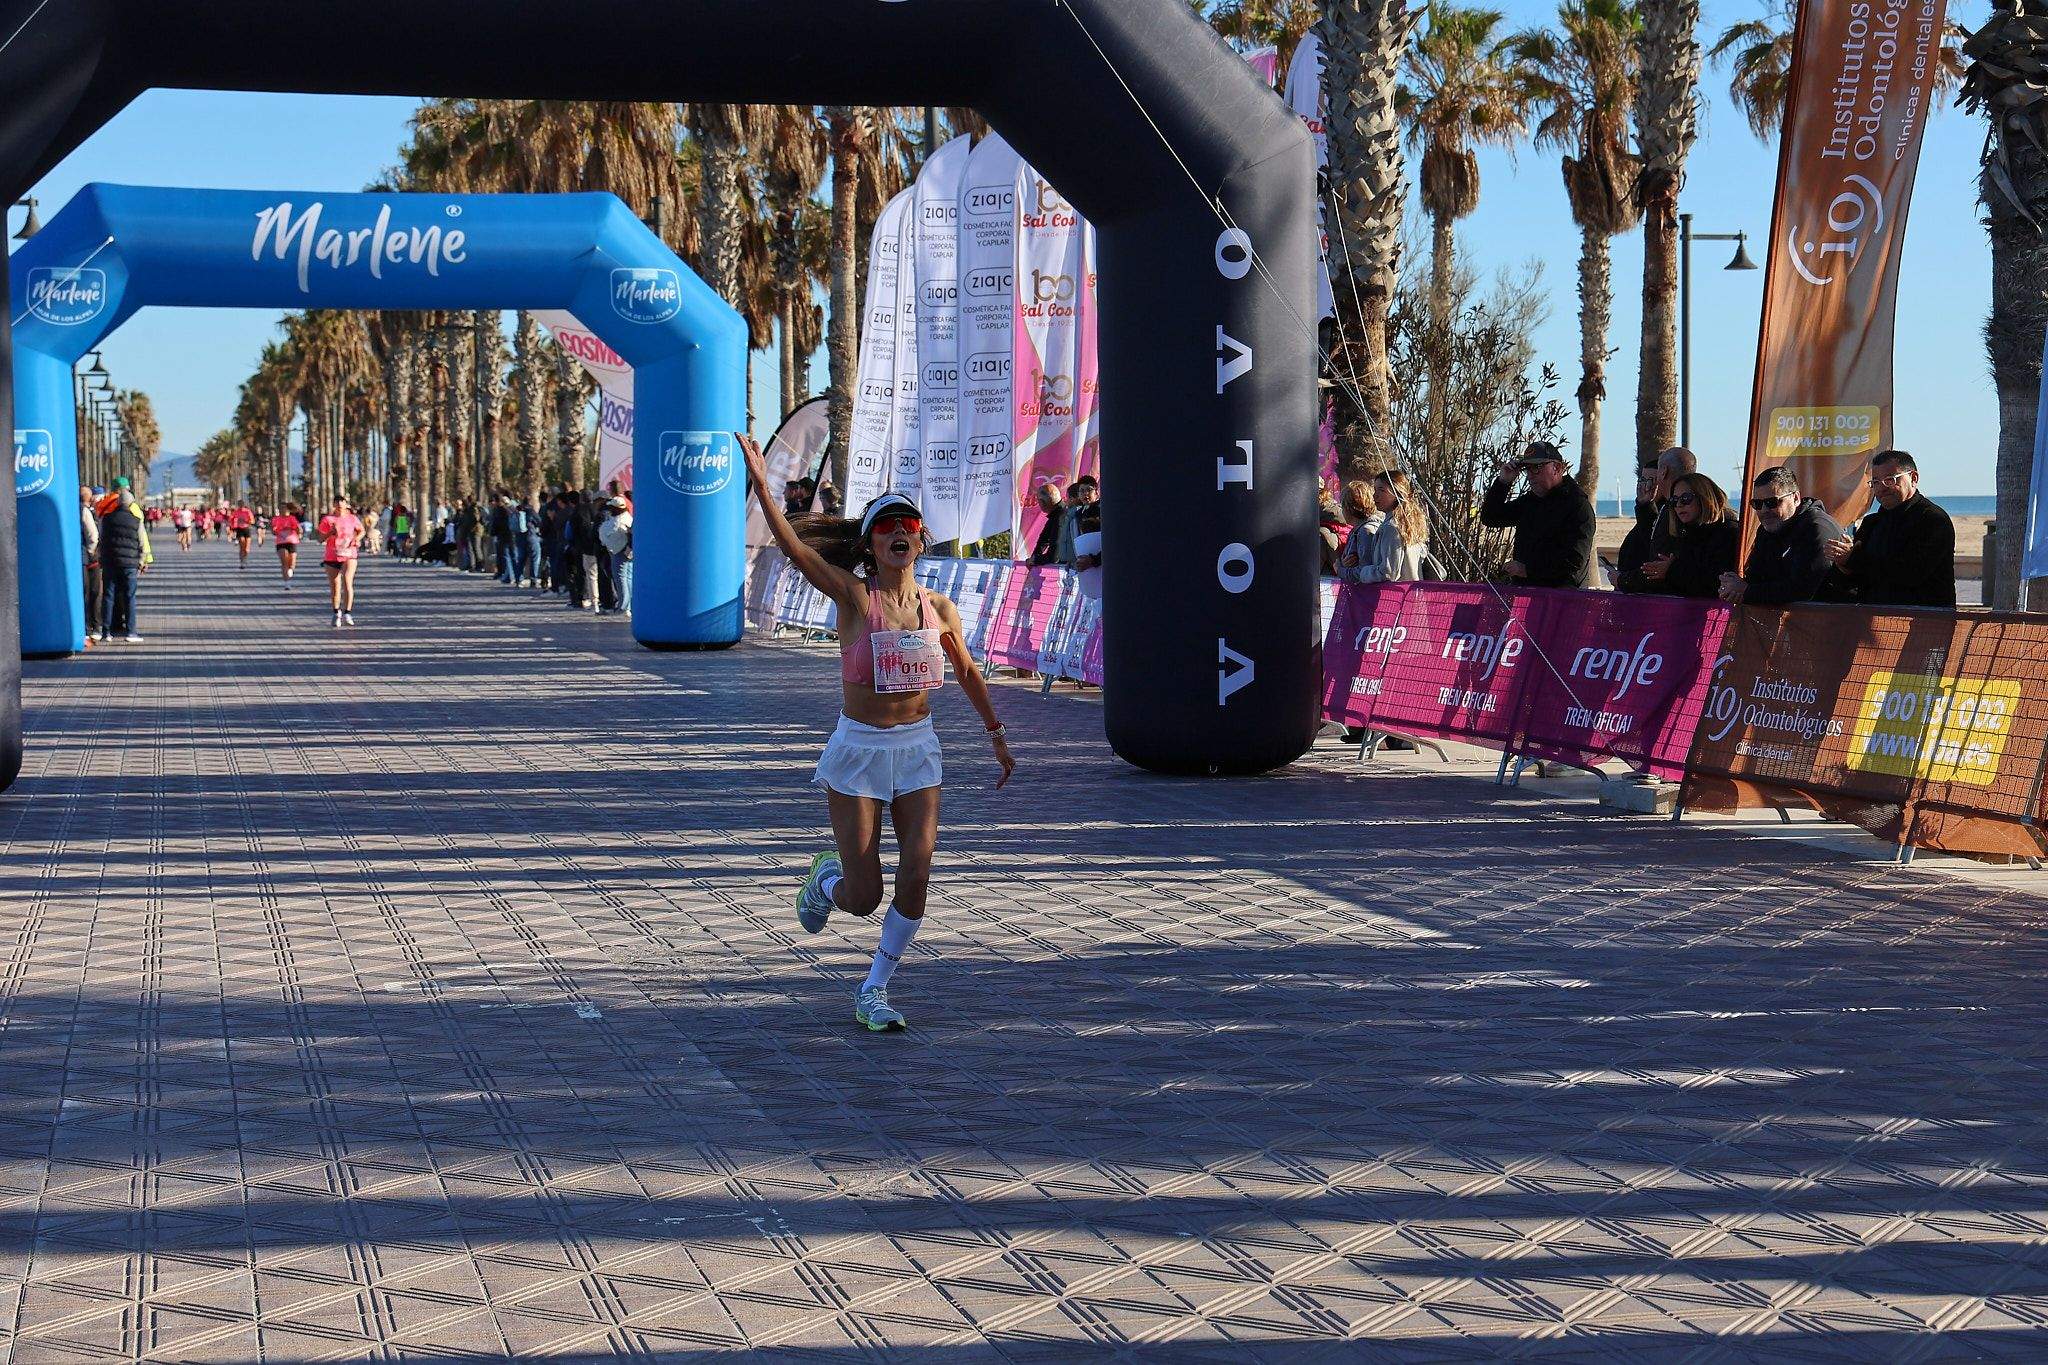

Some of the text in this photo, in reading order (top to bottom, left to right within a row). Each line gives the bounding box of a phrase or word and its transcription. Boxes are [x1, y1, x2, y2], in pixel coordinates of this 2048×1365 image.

[1821, 2, 1870, 159] Institutos
[1895, 85, 1921, 161] Clínicas
[1023, 213, 1047, 227] Sal
[252, 202, 466, 293] Marlene
[32, 280, 100, 310] Marlene
[616, 280, 676, 309] Marlene
[1021, 303, 1043, 317] Sal
[1777, 414, 1871, 431] 900 131 002
[1775, 432, 1870, 448] www.ioa.es
[664, 446, 729, 478] Marlene
[1214, 227, 1255, 706] VOLVO
[1441, 617, 1524, 681] renfe
[1569, 632, 1663, 701] renfe
[1437, 687, 1498, 713] TREN OFICIAL
[1750, 676, 1818, 704] Institutos
[1564, 706, 1592, 728] TREN
[1743, 704, 1844, 740] Odontológicos
